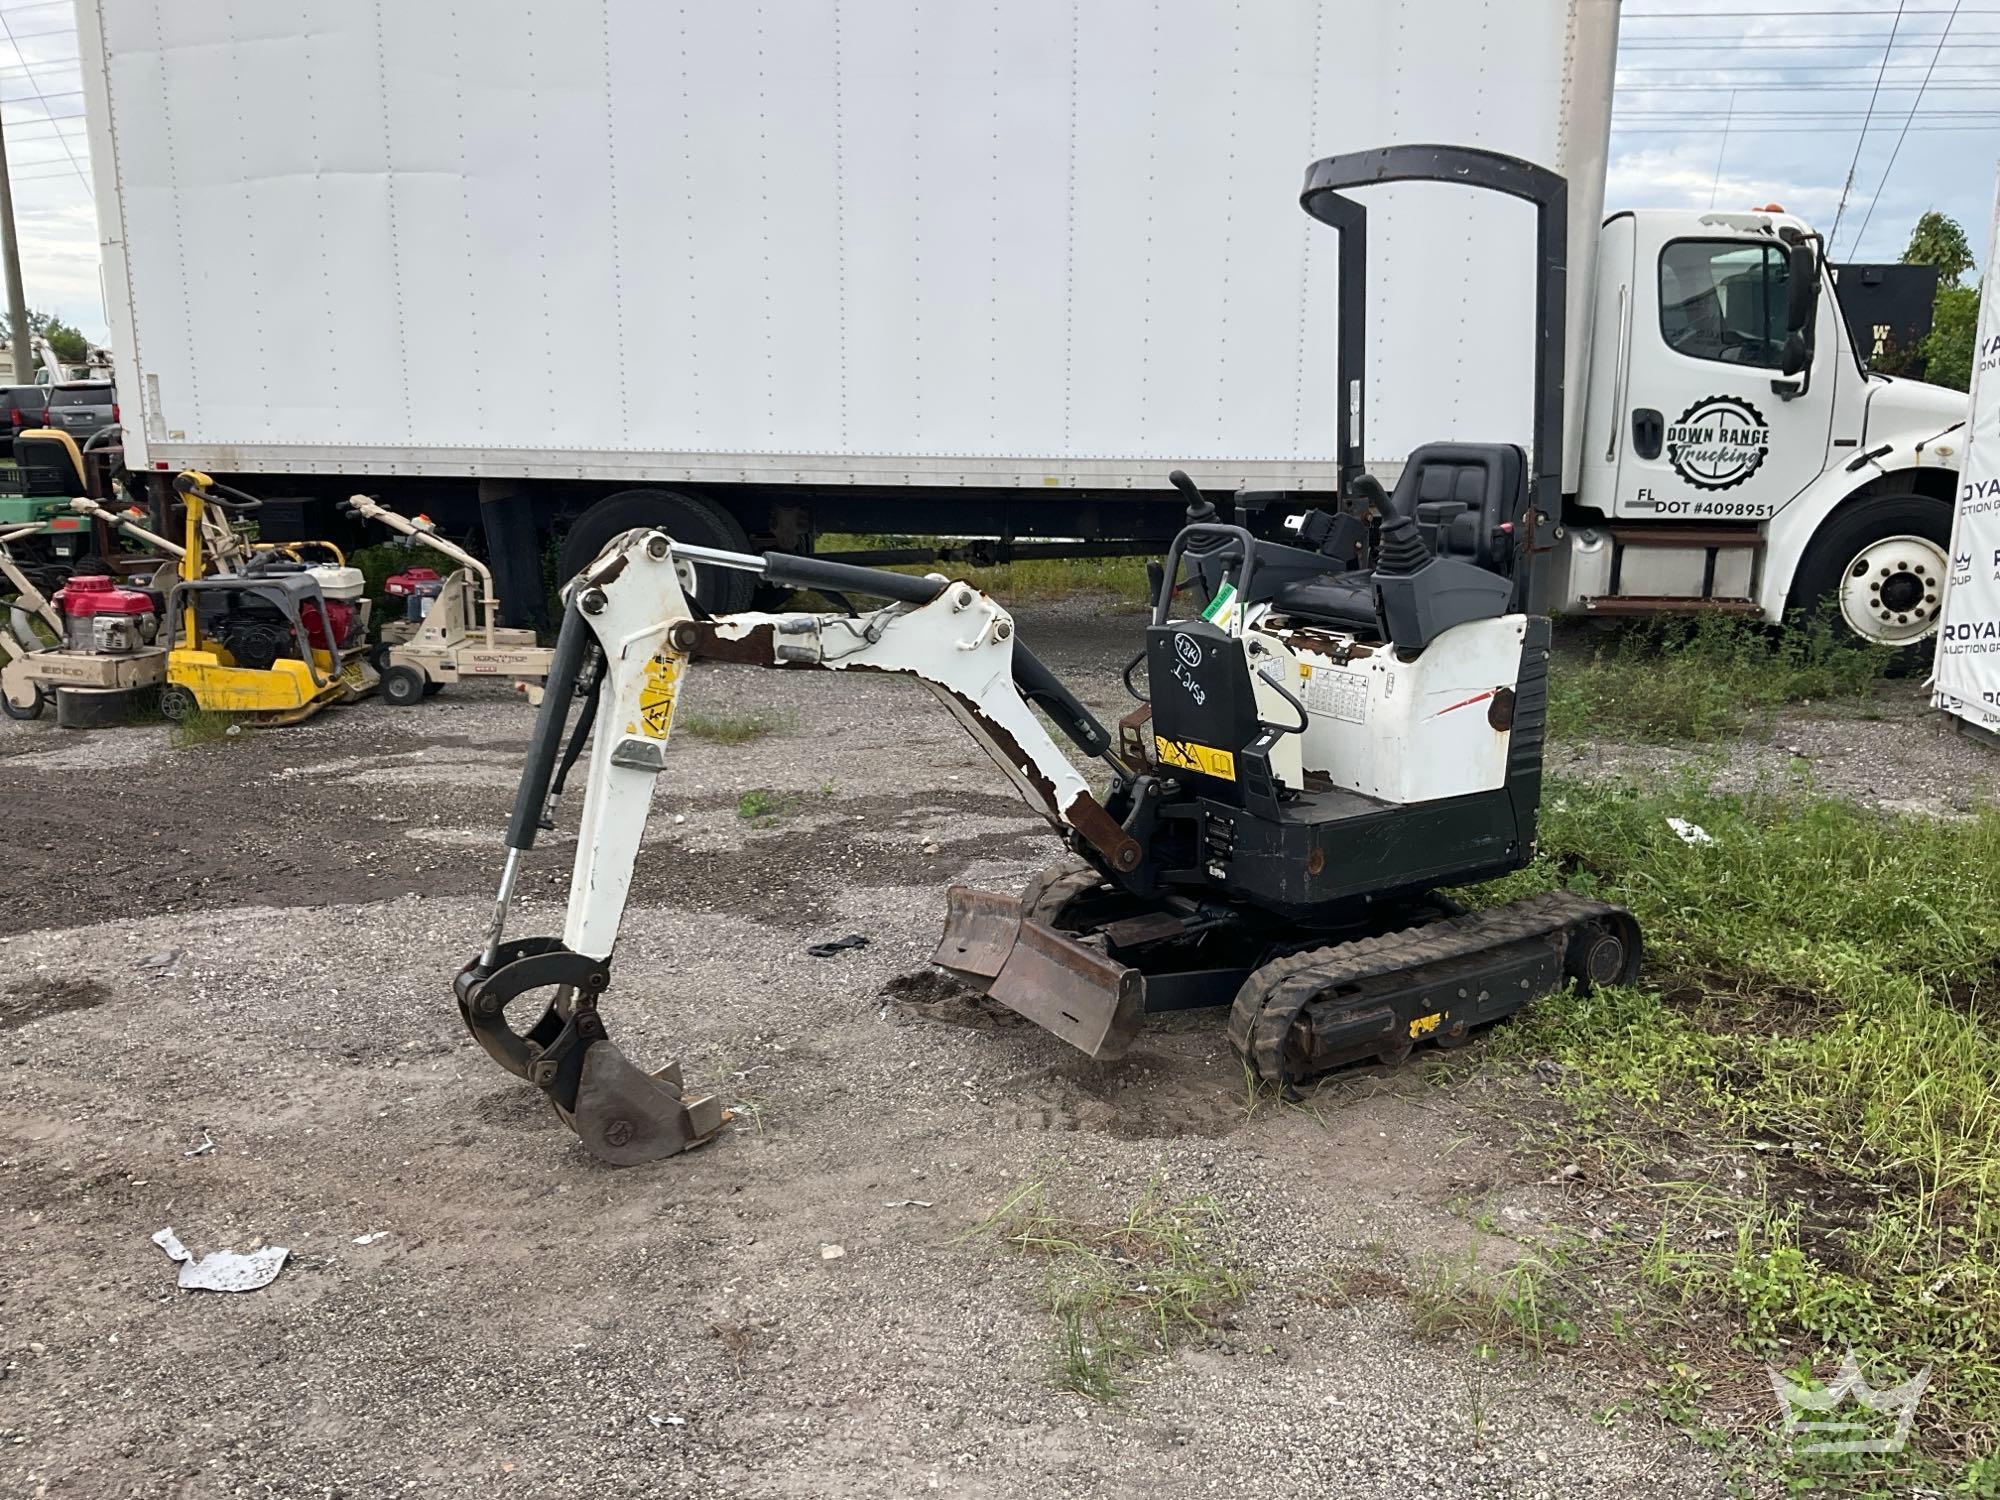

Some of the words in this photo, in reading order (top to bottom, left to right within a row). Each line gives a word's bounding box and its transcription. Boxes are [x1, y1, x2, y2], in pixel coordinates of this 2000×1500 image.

[1667, 427, 1713, 442] DOWN
[1719, 428, 1769, 444] RANGE
[1675, 445, 1762, 470] Trucking
[1637, 488, 1655, 501] FL
[1655, 501, 1690, 514] DOT
[1693, 502, 1774, 517] #4098951
[1943, 644, 1987, 655] AUCTION
